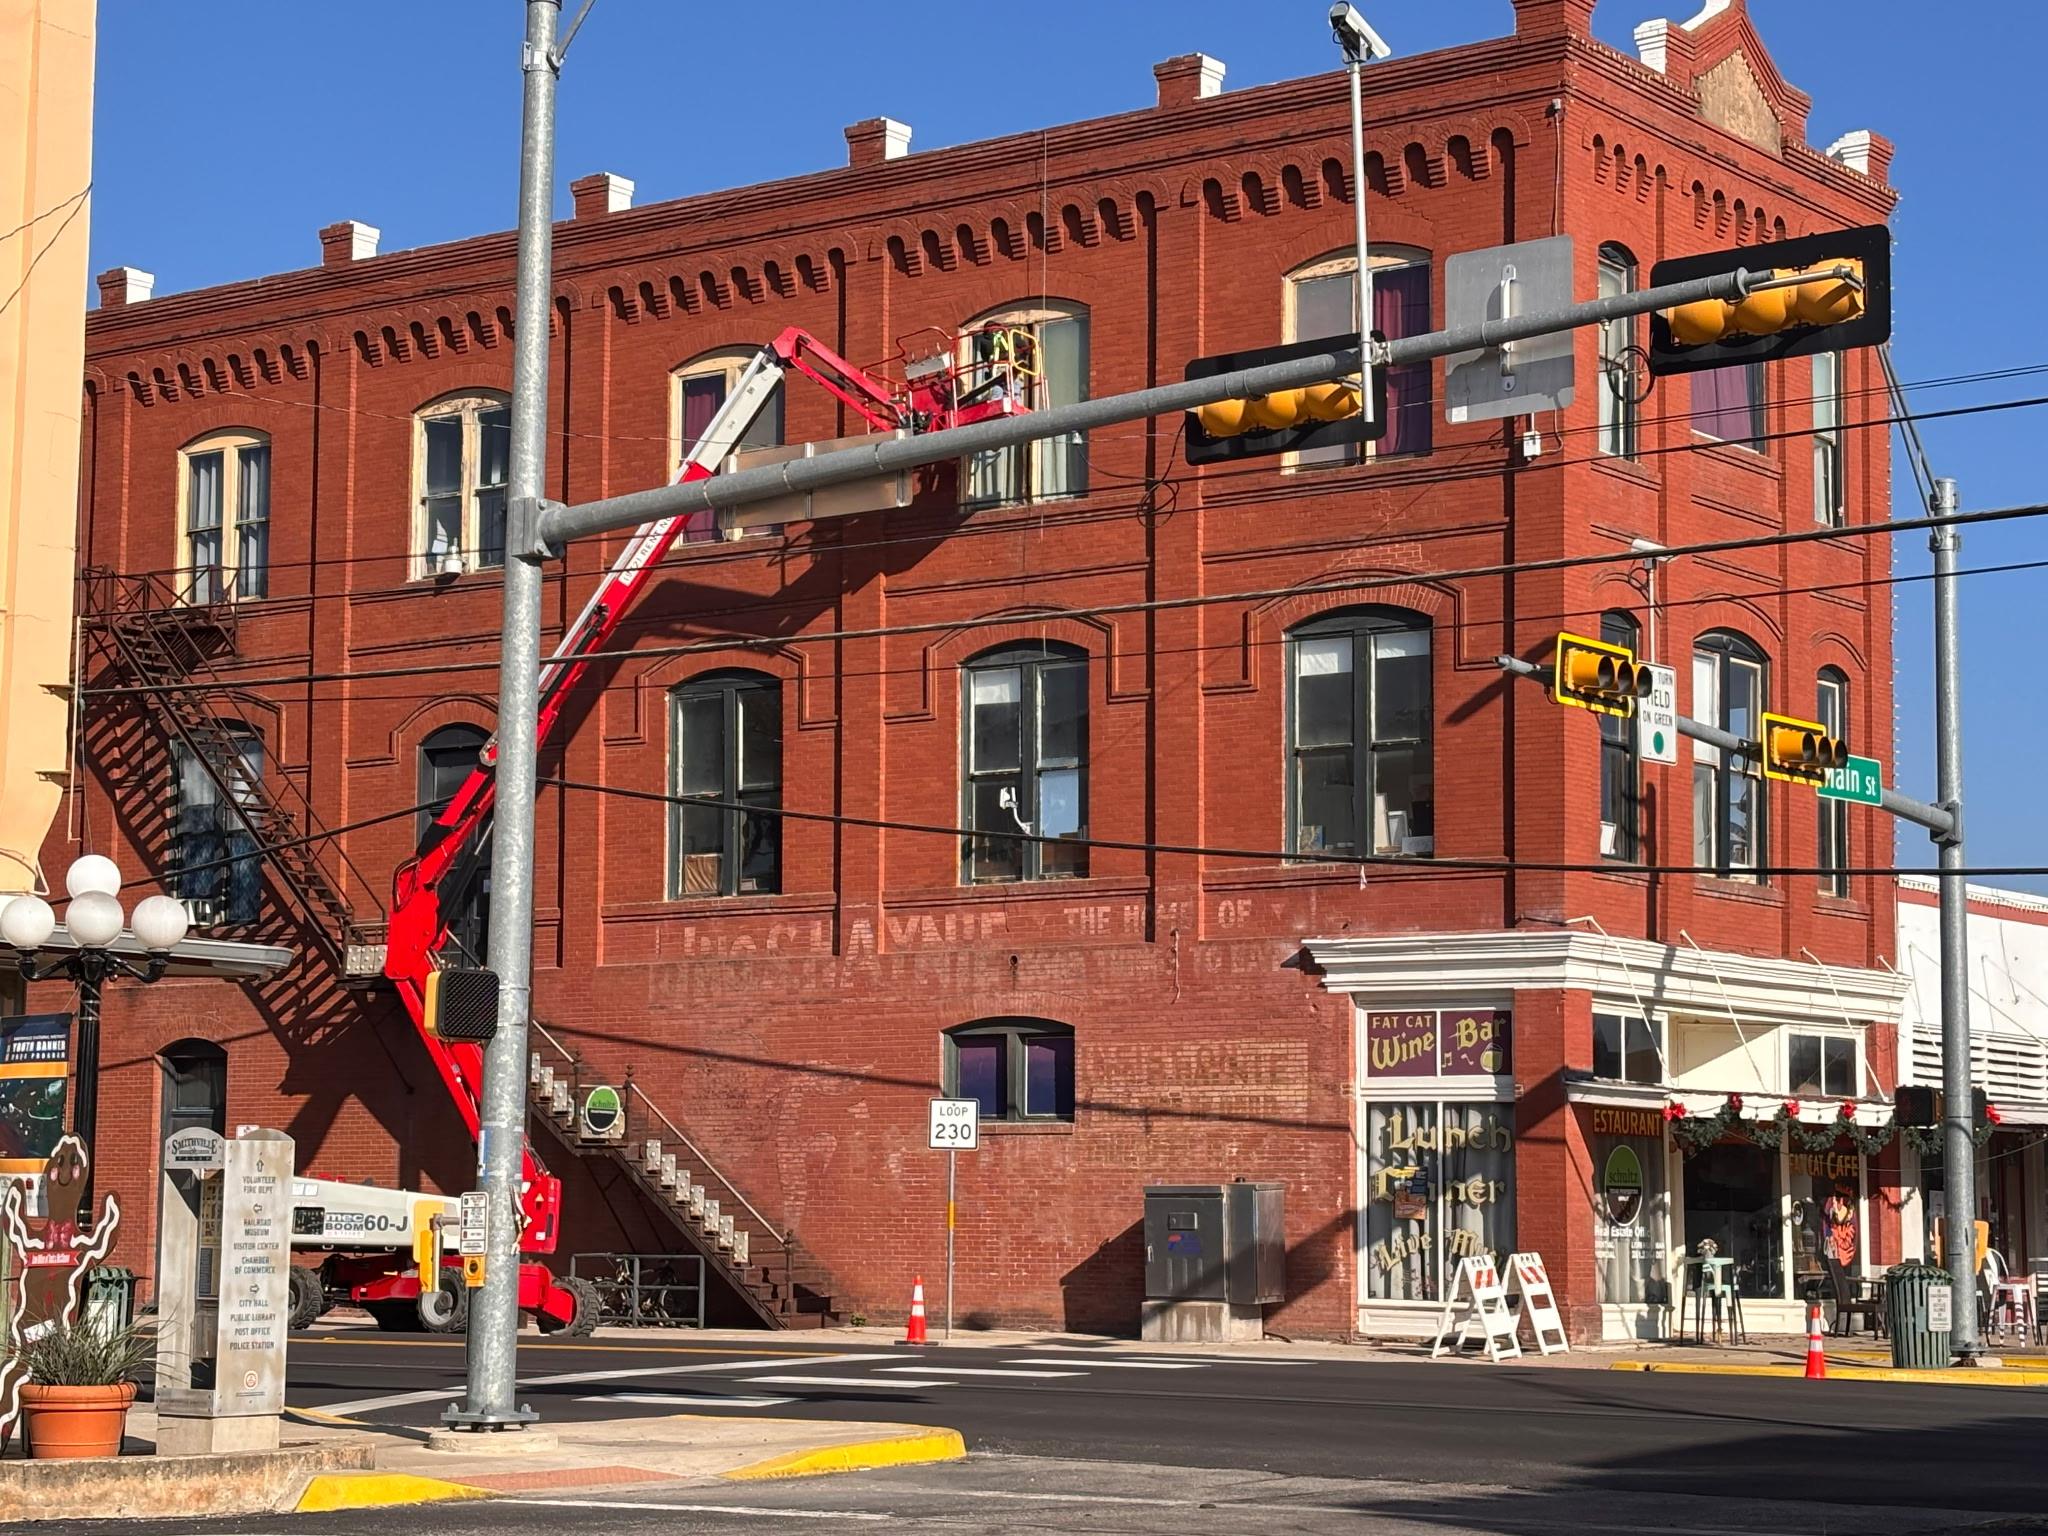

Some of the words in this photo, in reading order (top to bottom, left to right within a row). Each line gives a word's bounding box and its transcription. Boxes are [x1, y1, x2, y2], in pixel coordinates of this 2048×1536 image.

[1658, 671, 1674, 685] TURN
[1642, 710, 1651, 723] ON
[1654, 711, 1673, 727] GREEN
[1825, 762, 1860, 793] Main
[1063, 905, 1111, 936] THE
[1218, 899, 1252, 928] OF
[1372, 1016, 1400, 1029] FAT
[1405, 1015, 1433, 1028] CAT
[1370, 1031, 1436, 1070] Wine
[1449, 1017, 1506, 1051] Bar
[939, 1106, 969, 1117] LOOP
[1593, 1109, 1661, 1136] ESTAURANT
[935, 1123, 971, 1140] 230
[1386, 1112, 1512, 1153] Lunch
[242, 1176, 276, 1184] VOLUNTEER
[243, 1186, 257, 1194] FIRE
[243, 1218, 271, 1226] RAILROAD
[325, 1222, 364, 1231] BOOM
[364, 1214, 408, 1232] 60-J
[244, 1228, 270, 1236] MUSEUM
[233, 1242, 256, 1250] VISITOR
[257, 1242, 279, 1250] CENTER
[1377, 1232, 1433, 1272] Live
[241, 1256, 269, 1265] CHAMBER
[234, 1266, 242, 1274] OF
[243, 1265, 276, 1274] COMMERCE
[230, 1313, 250, 1321] PUBLIC
[251, 1313, 276, 1321] LIBRARY
[234, 1327, 249, 1336] POST
[250, 1327, 271, 1335] OFFICE
[229, 1342, 250, 1350] POLICE
[251, 1341, 275, 1349] STATION
